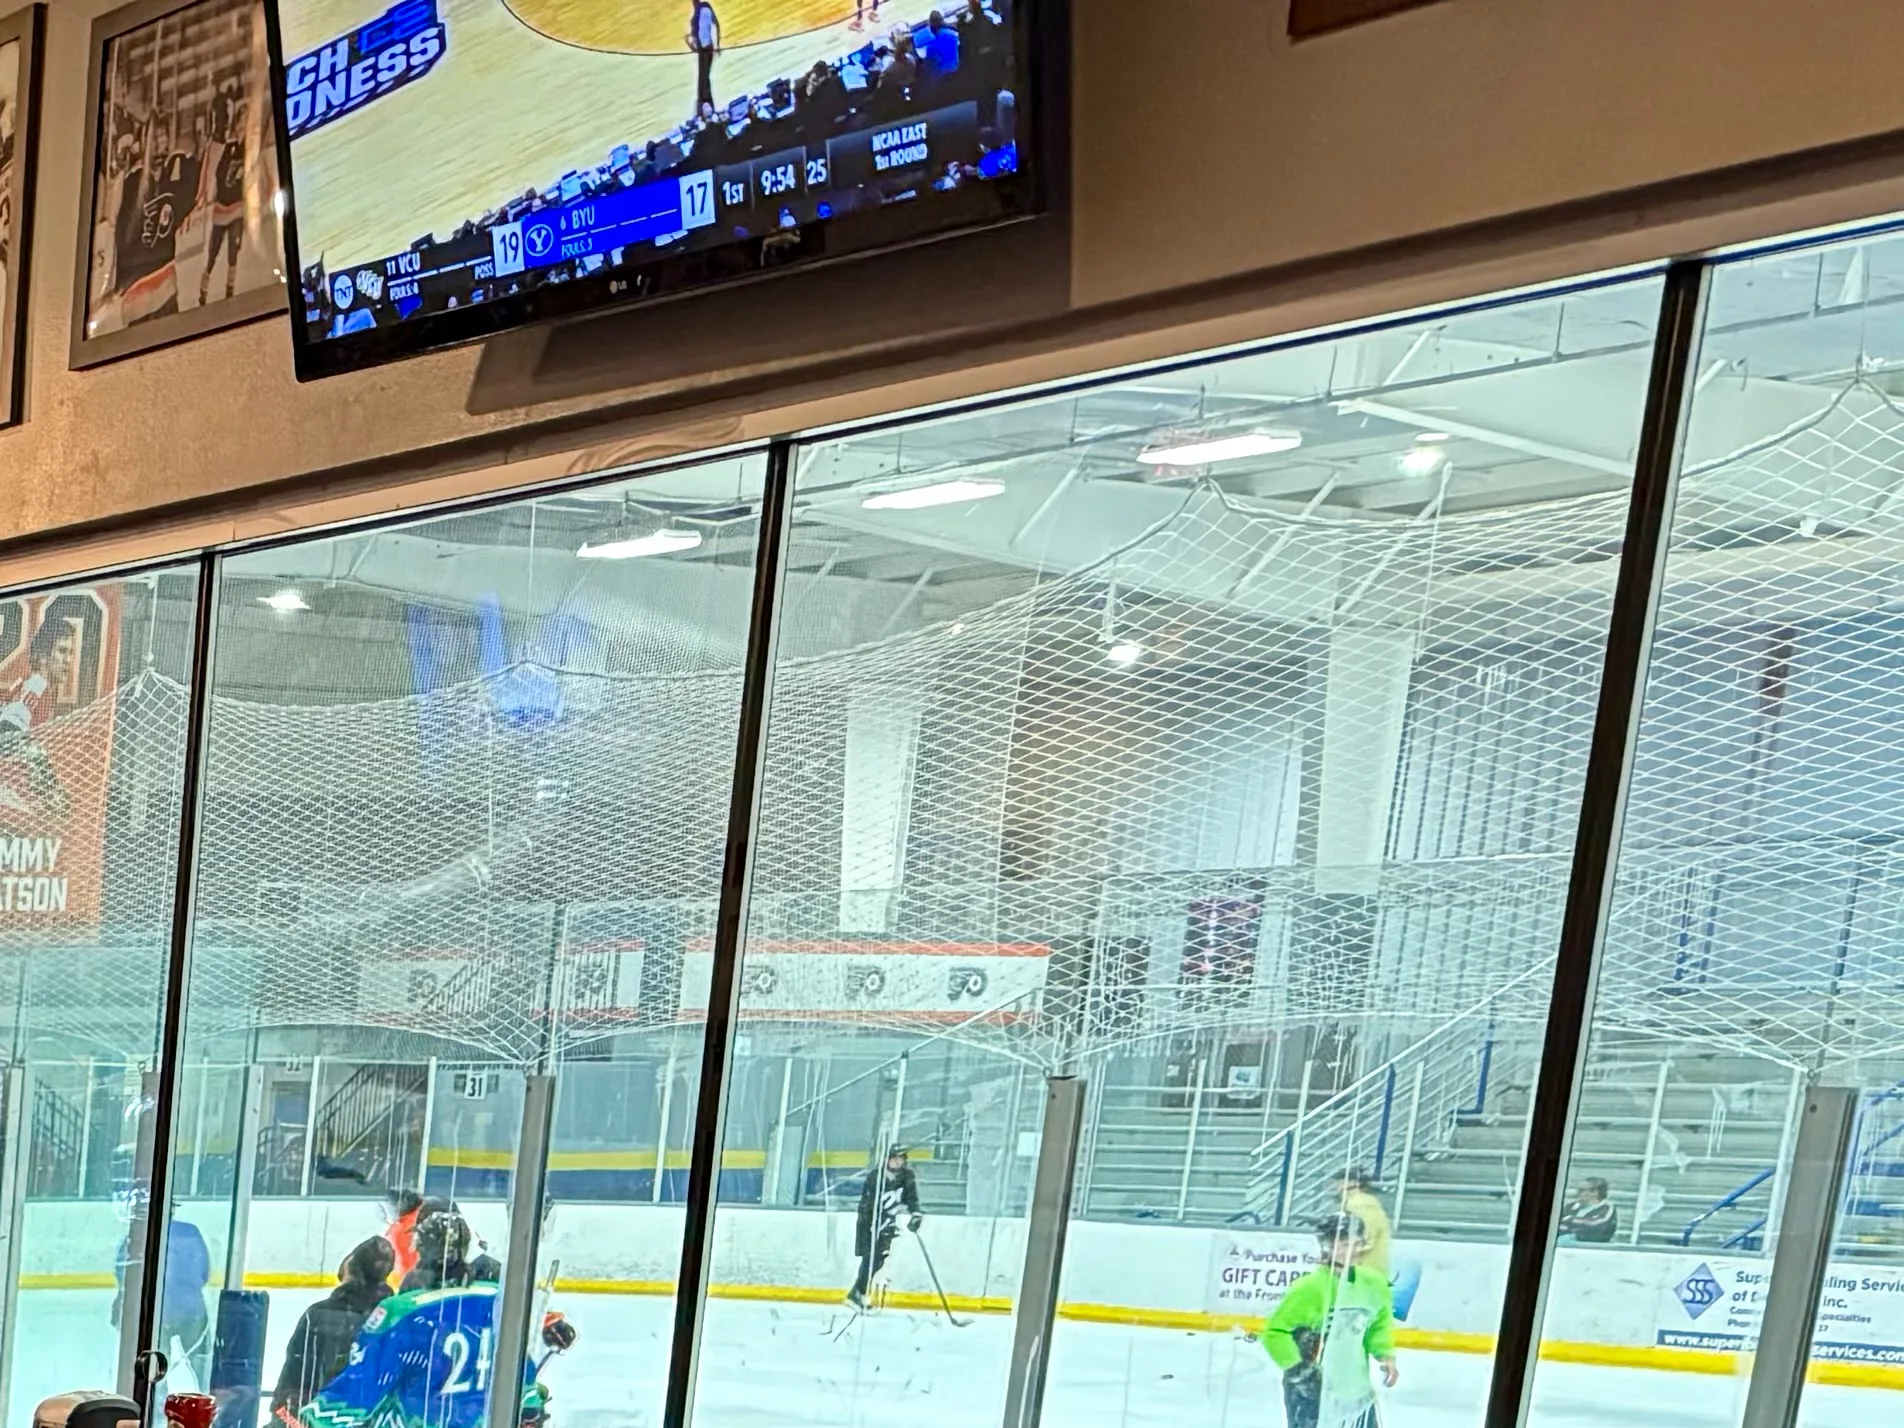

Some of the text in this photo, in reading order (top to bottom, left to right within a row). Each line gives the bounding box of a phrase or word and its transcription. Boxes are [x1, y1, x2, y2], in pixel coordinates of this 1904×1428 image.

[872, 123, 927, 151] NCAA EAST
[890, 143, 928, 166] ROUND
[761, 164, 796, 195] 9:54
[807, 158, 827, 186] 25
[686, 181, 708, 217] 17
[572, 205, 596, 229] BYU
[500, 231, 520, 264] 19
[398, 252, 421, 275] VCU
[468, 1076, 483, 1098] 31
[1222, 1267, 1312, 1287] GIFT CAR
[1825, 1276, 1857, 1291] ling
[1255, 1288, 1286, 1301] Fron
[1732, 1290, 1747, 1303] of
[1822, 1296, 1848, 1309] Inc.
[1820, 1311, 1872, 1324] pecialties
